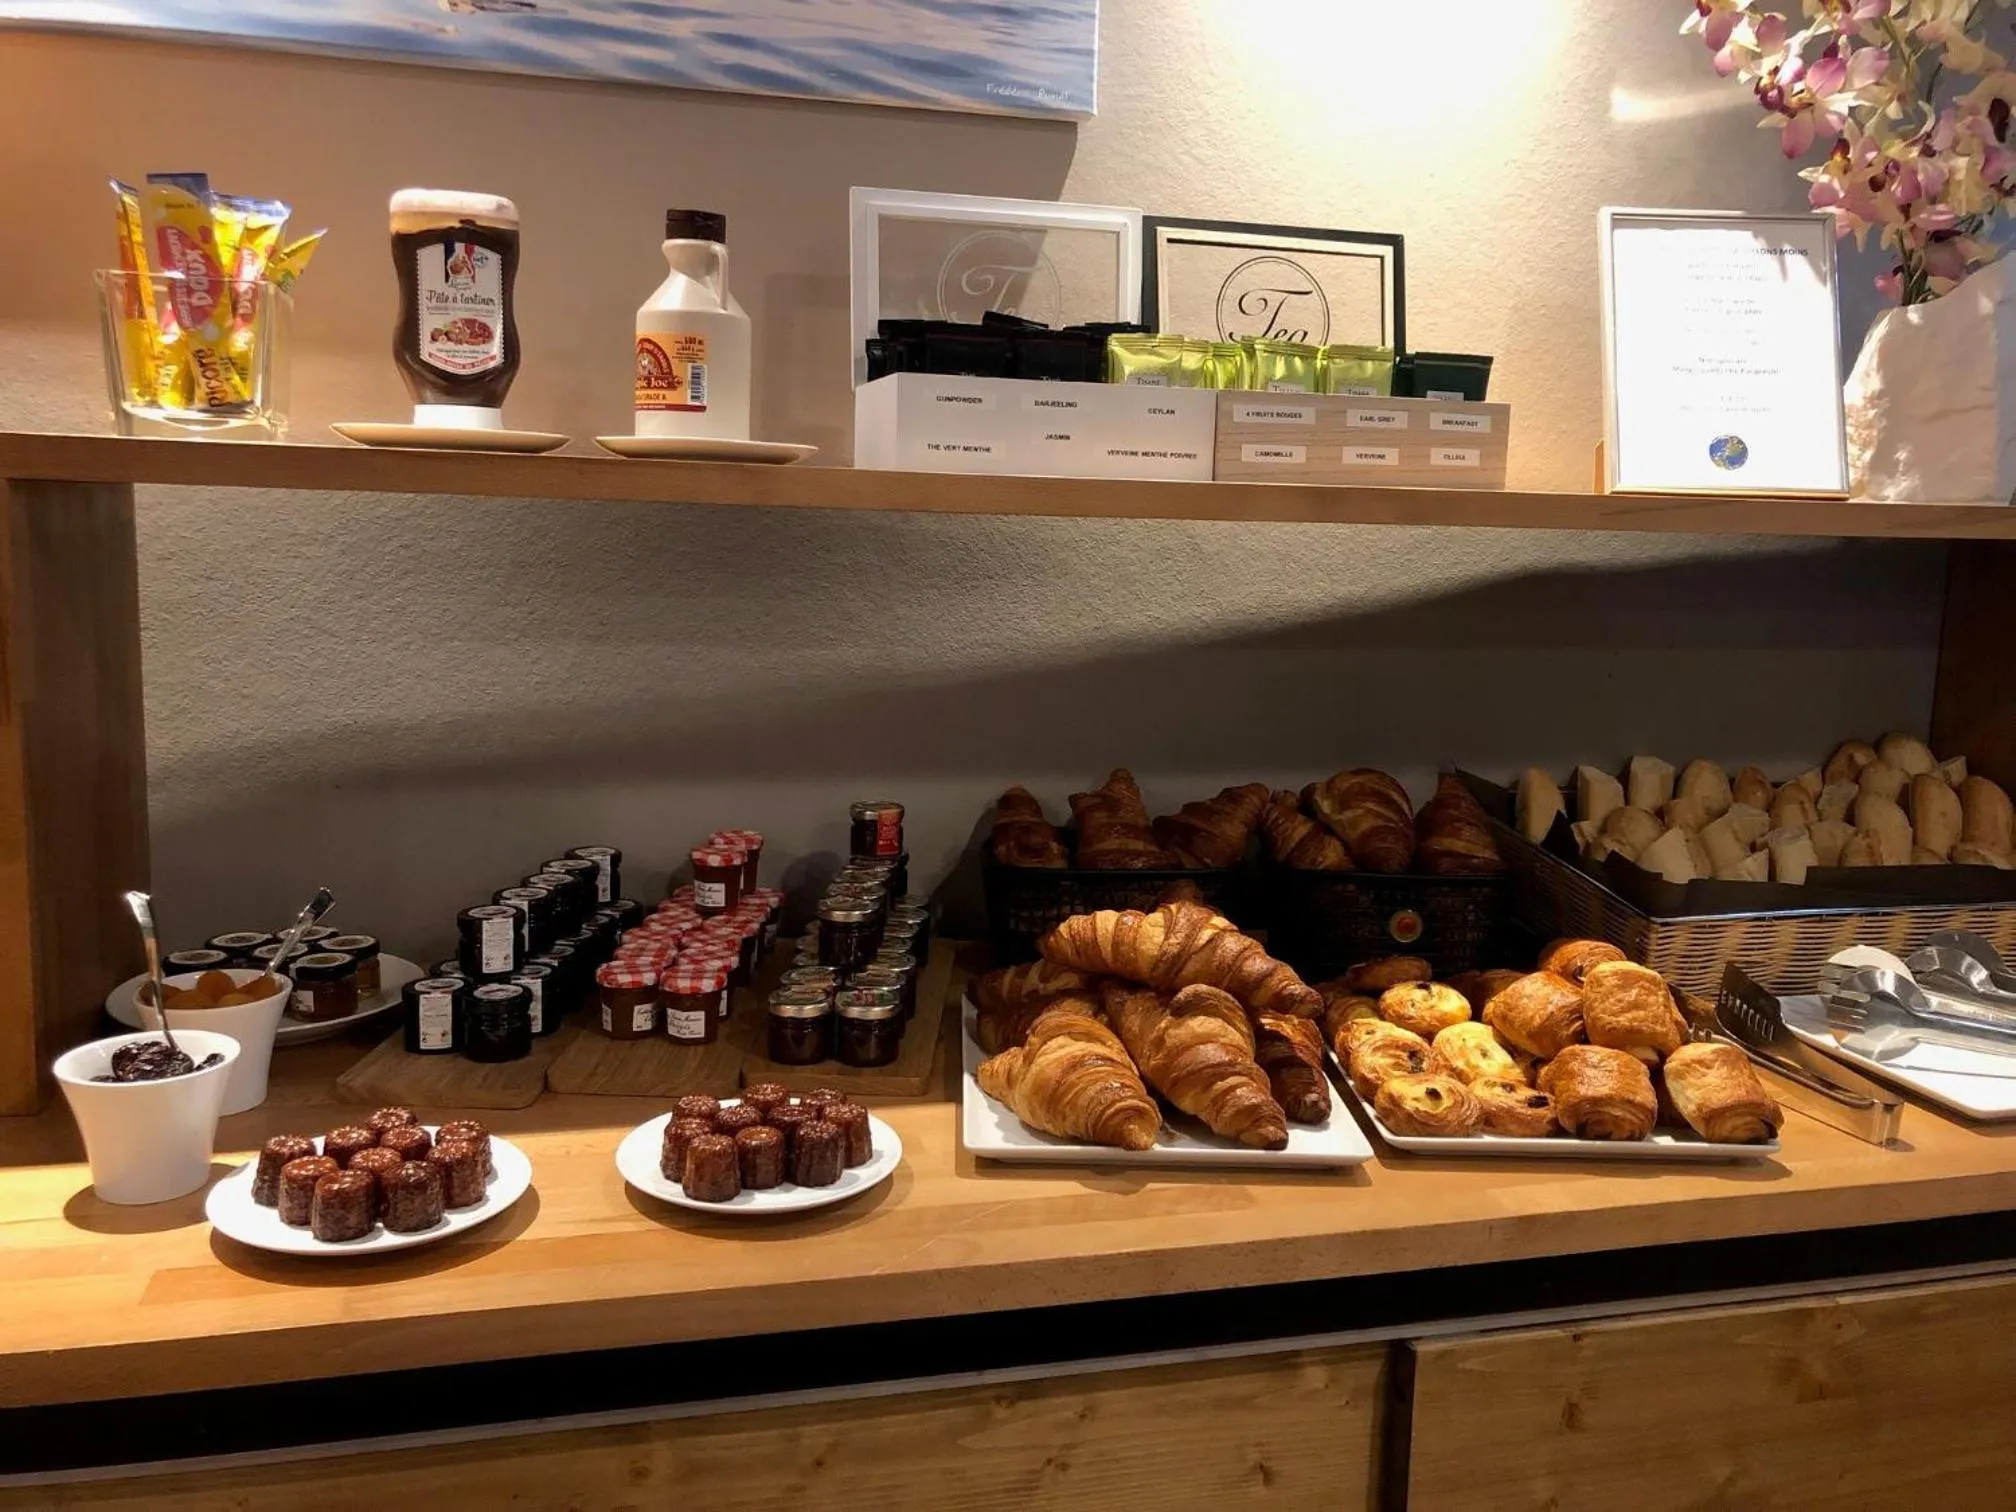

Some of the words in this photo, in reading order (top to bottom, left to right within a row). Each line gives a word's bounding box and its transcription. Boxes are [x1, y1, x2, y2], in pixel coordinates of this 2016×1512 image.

[936, 395, 983, 405] GUNPOWDER
[1034, 400, 1078, 409] DARJEELING
[1147, 407, 1176, 415] CEYLAN
[1045, 433, 1071, 441] JASMIN
[927, 443, 942, 451] THE
[943, 444, 961, 452] VERT
[961, 445, 992, 453] MENTHE
[1141, 451, 1168, 459] MENTHE
